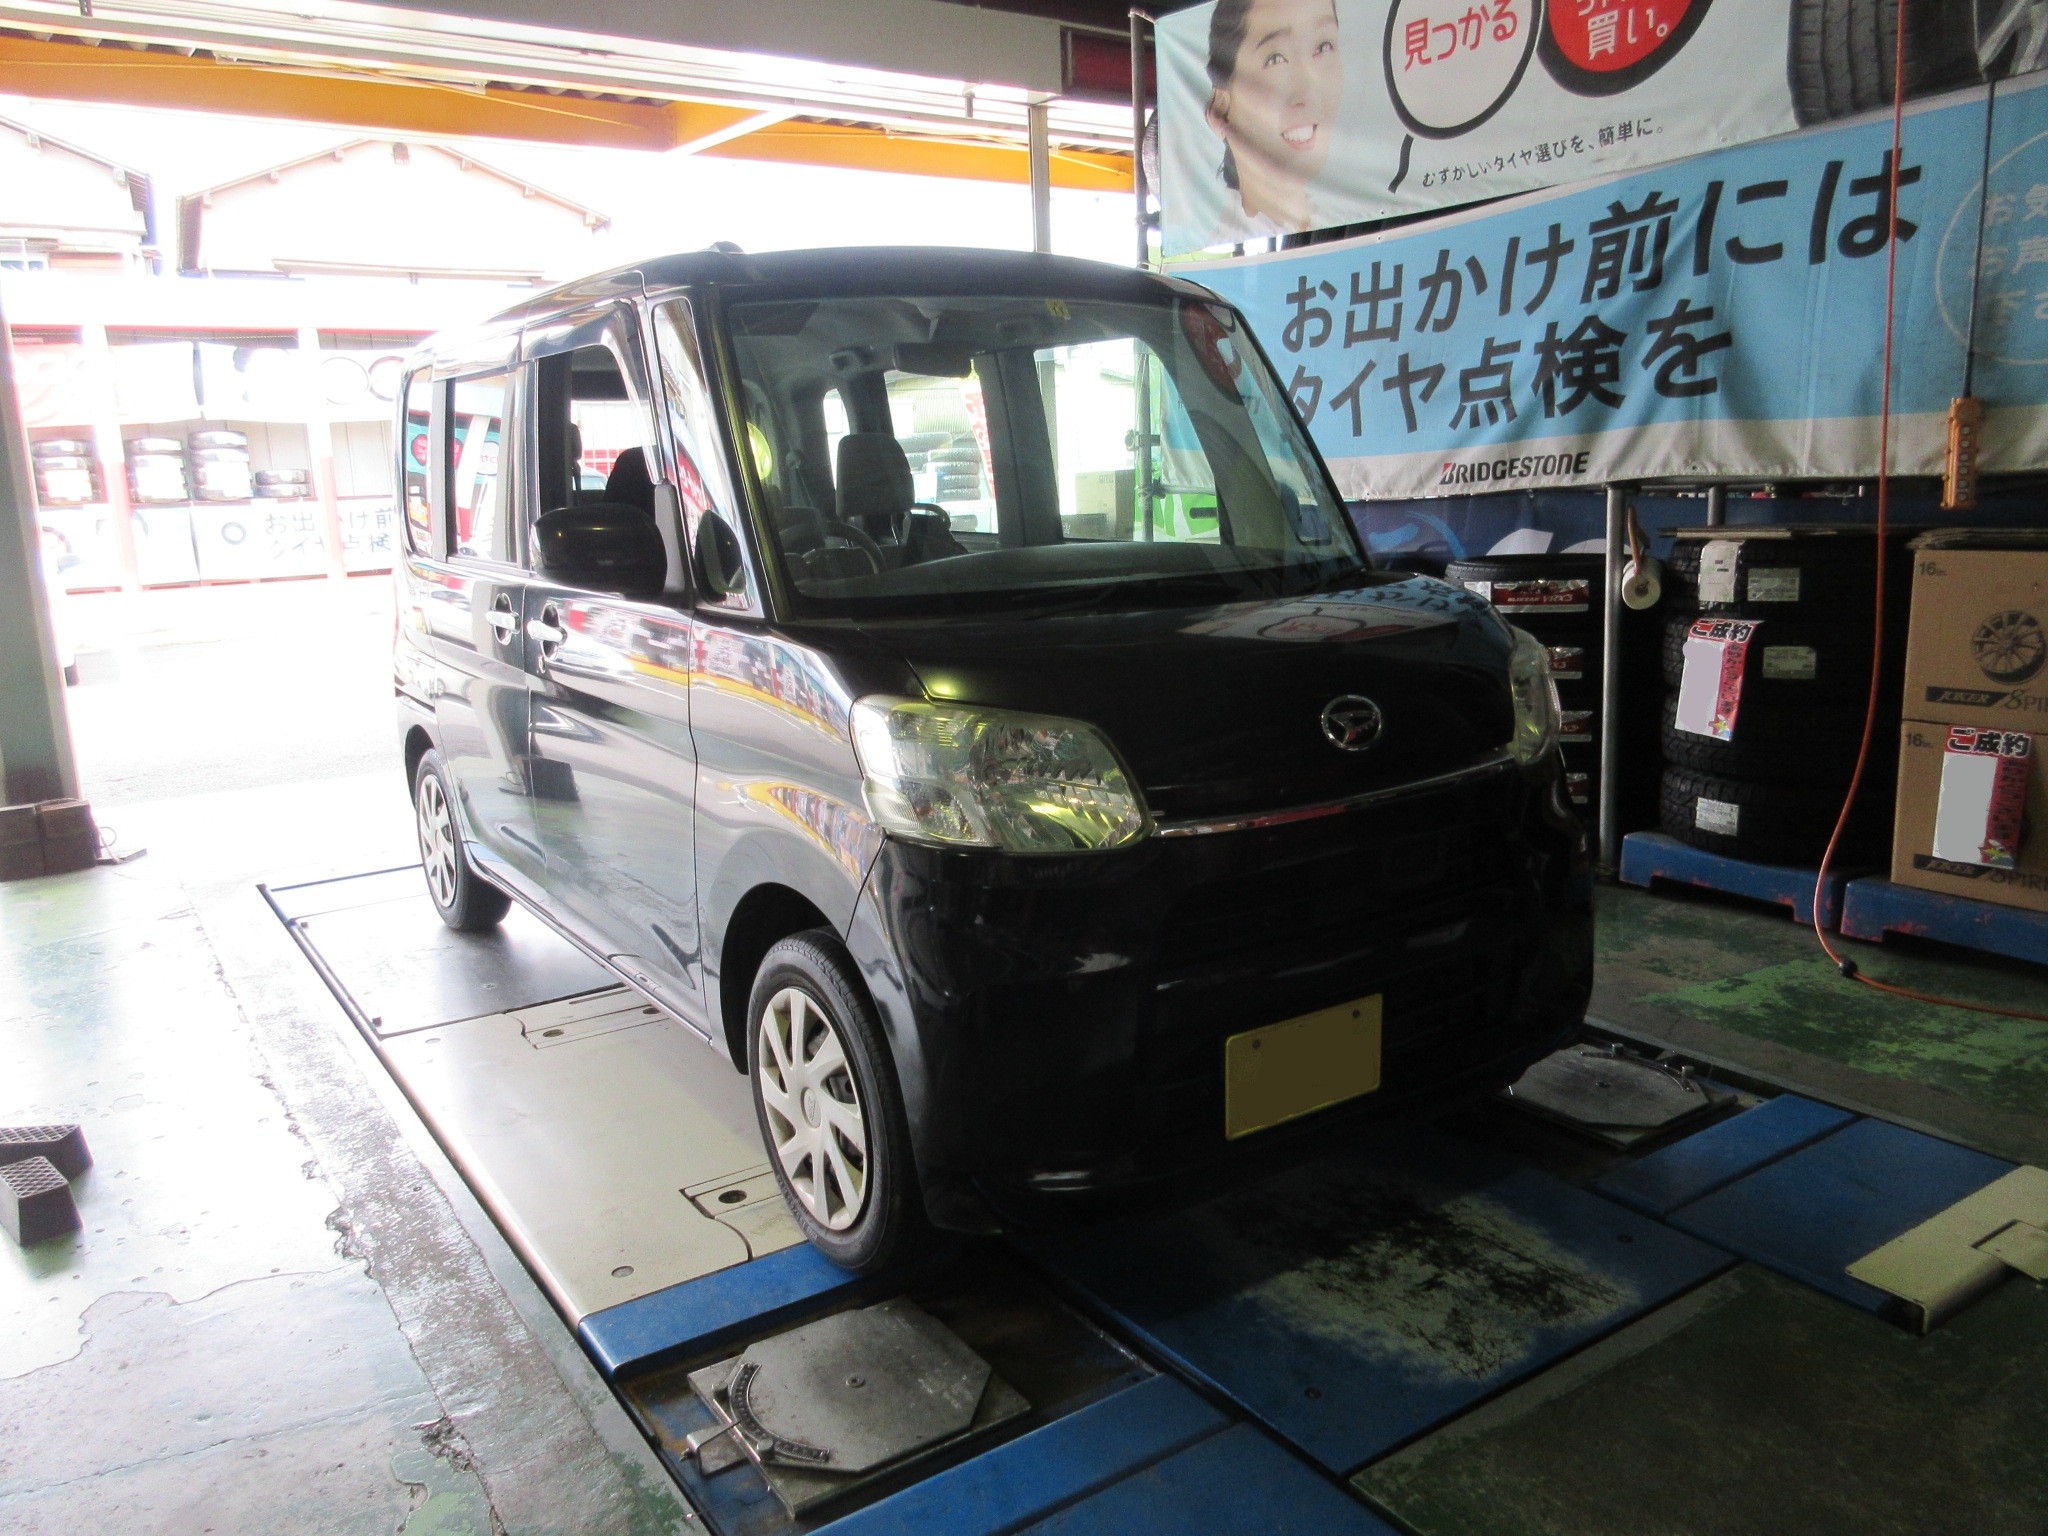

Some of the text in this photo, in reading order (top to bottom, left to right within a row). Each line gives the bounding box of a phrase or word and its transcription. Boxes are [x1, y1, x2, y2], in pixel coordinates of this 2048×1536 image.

[1403, 0, 1518, 71] 見つかる
[1587, 8, 1669, 61] 買い。
[1421, 117, 1664, 188] むずかしいタイヤ選びを、簡単に。
[1280, 147, 1922, 355] お出かけ前には
[1287, 299, 1733, 439] タイヤ点検を
[1439, 452, 1591, 486] BRIDGESTONE
[1690, 619, 1754, 643] ご成約
[1947, 727, 2031, 758] ご成約
